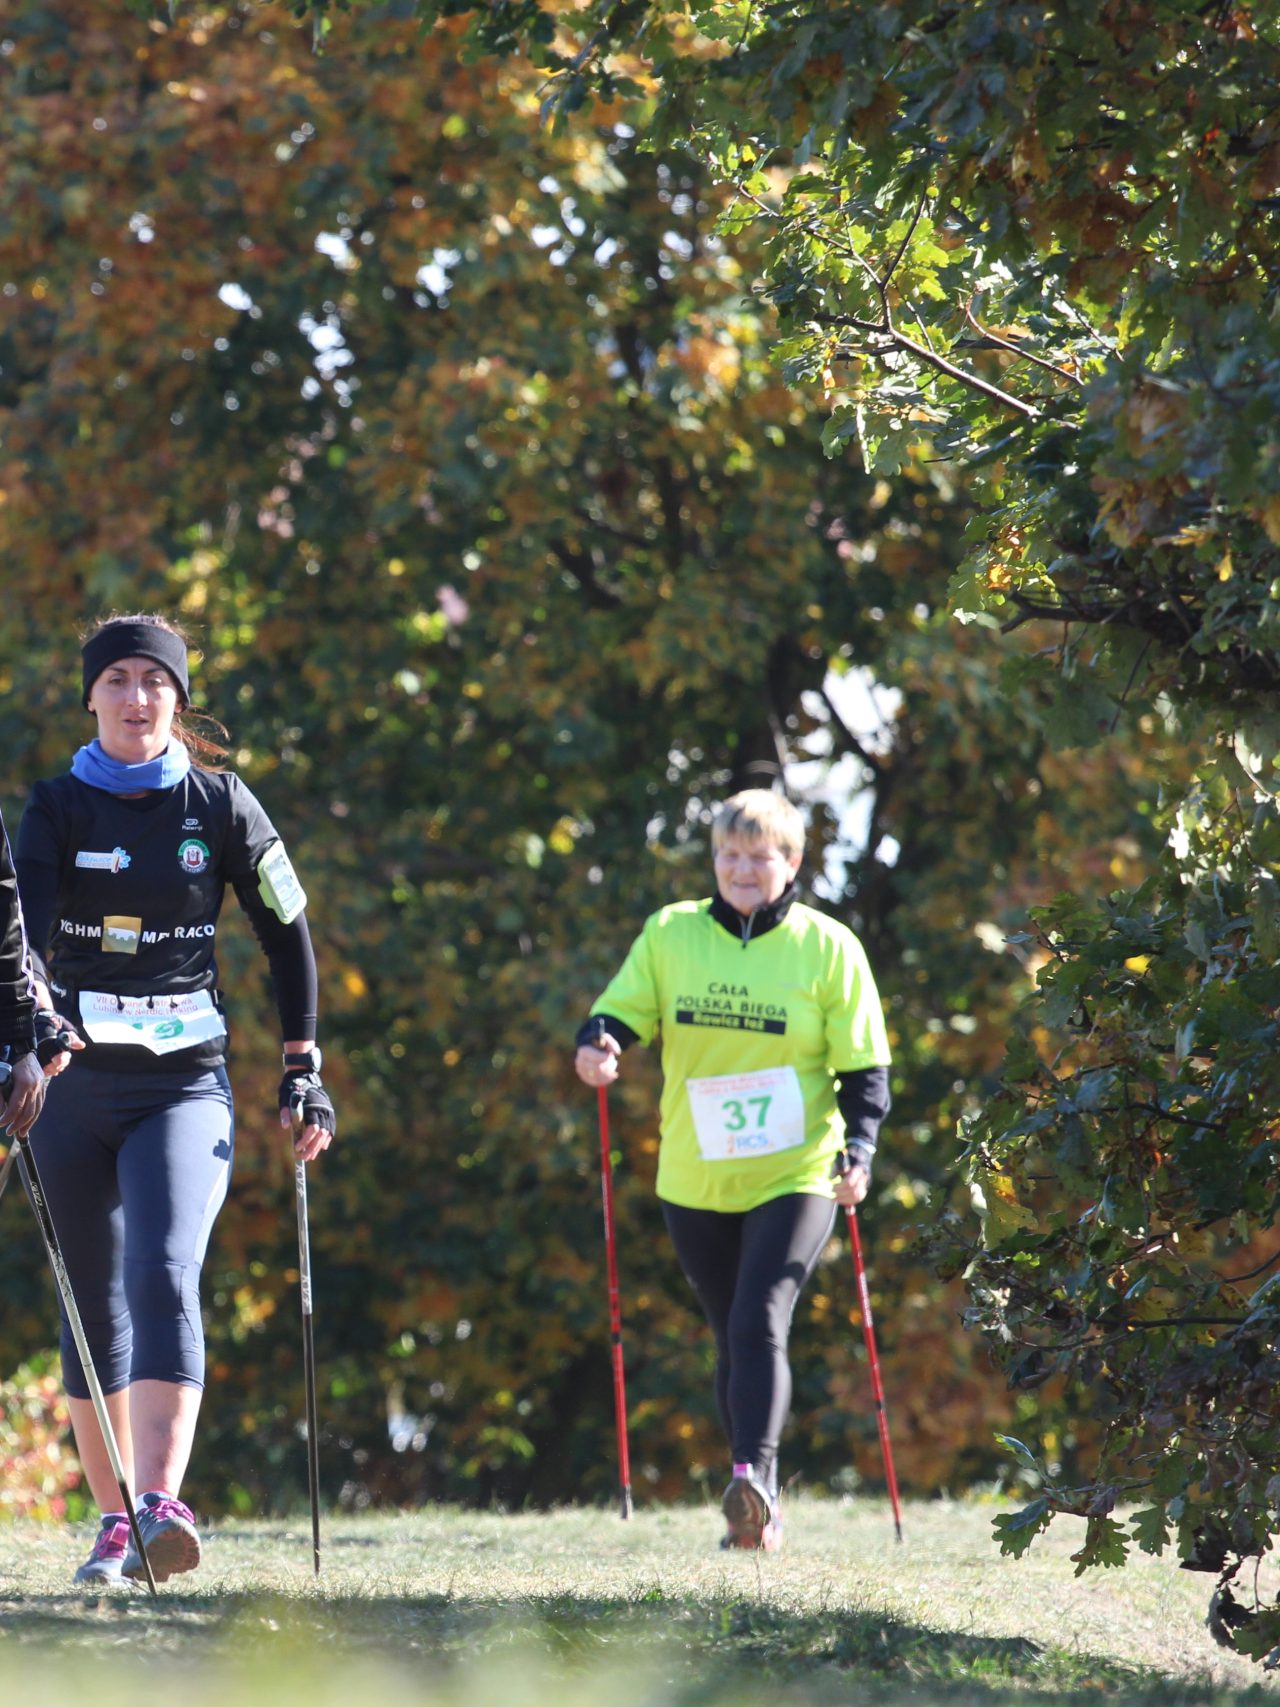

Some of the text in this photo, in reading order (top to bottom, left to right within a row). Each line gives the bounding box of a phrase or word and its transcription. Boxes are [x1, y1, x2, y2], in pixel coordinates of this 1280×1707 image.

[676, 995, 787, 1018] POLSKA BIEGA
[722, 1094, 772, 1131] 37
